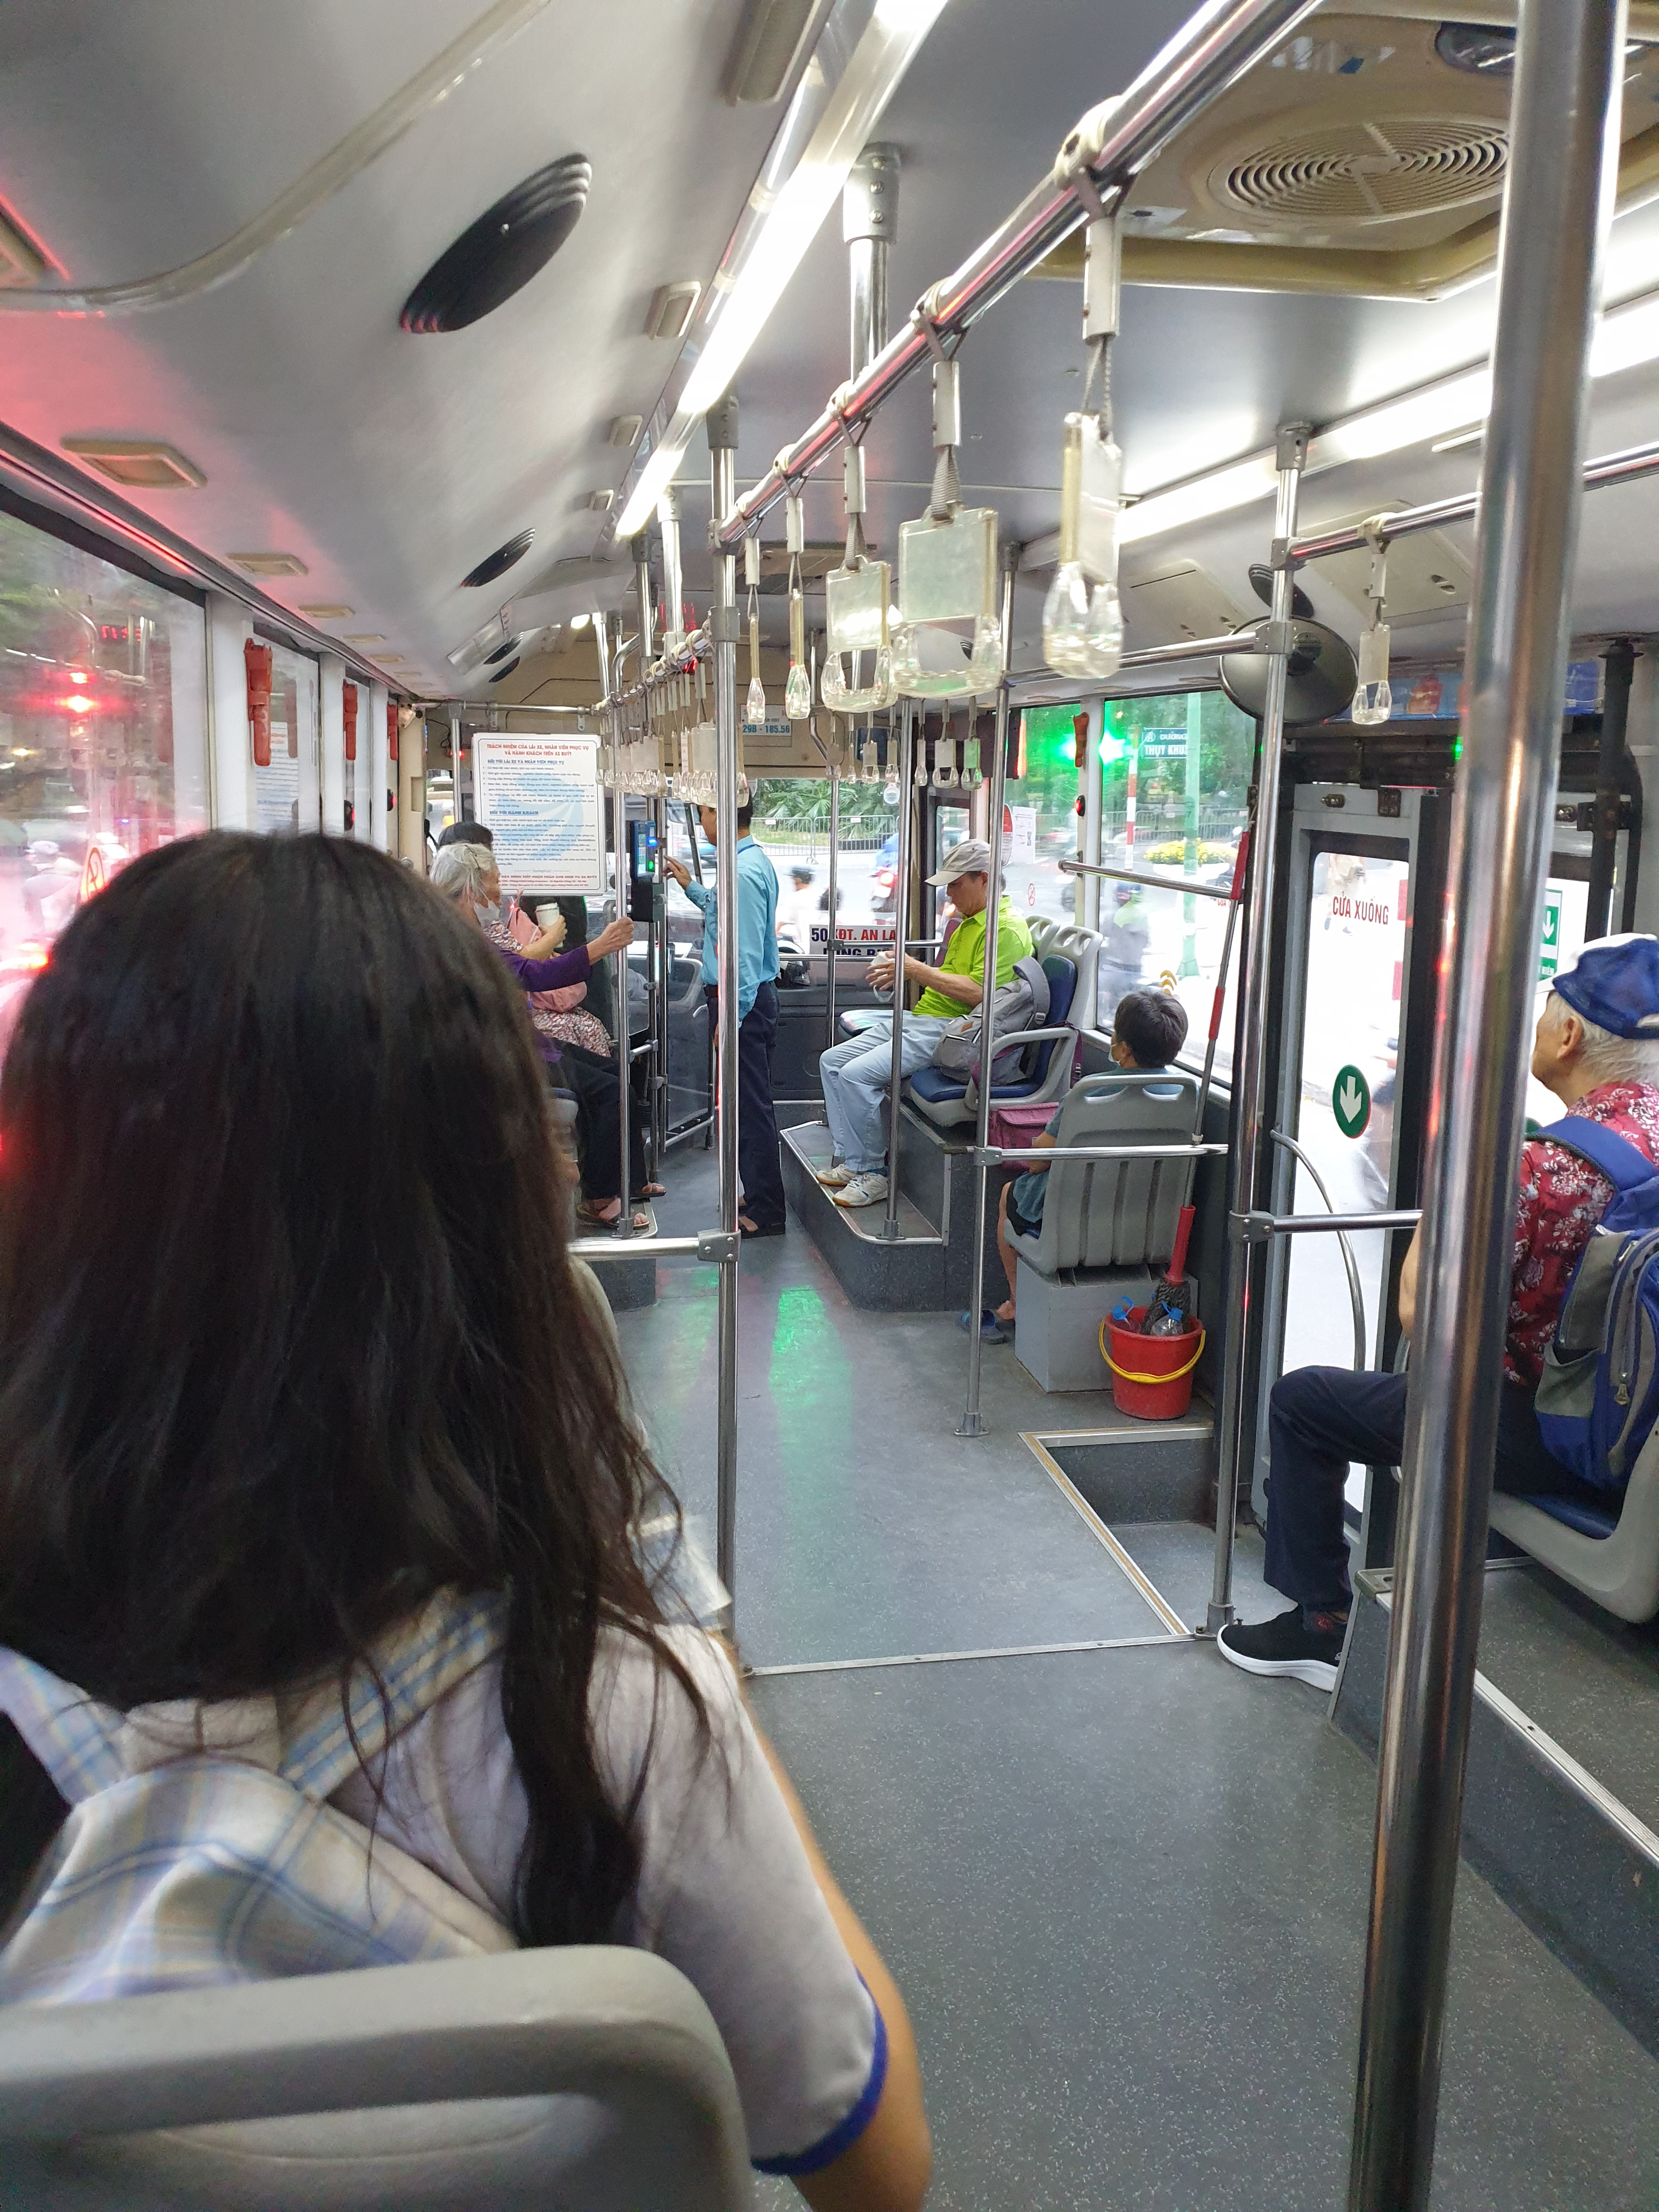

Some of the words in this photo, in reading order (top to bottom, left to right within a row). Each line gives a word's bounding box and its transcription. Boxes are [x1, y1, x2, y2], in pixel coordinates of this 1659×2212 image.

[765, 725, 789, 733] 185.56
[1167, 744, 1188, 755] KHU
[1333, 890, 1351, 918] CỬA
[1354, 895, 1389, 926] XUỐNG
[811, 928, 828, 942] 50
[861, 929, 878, 940] AN
[882, 929, 896, 940] LA
